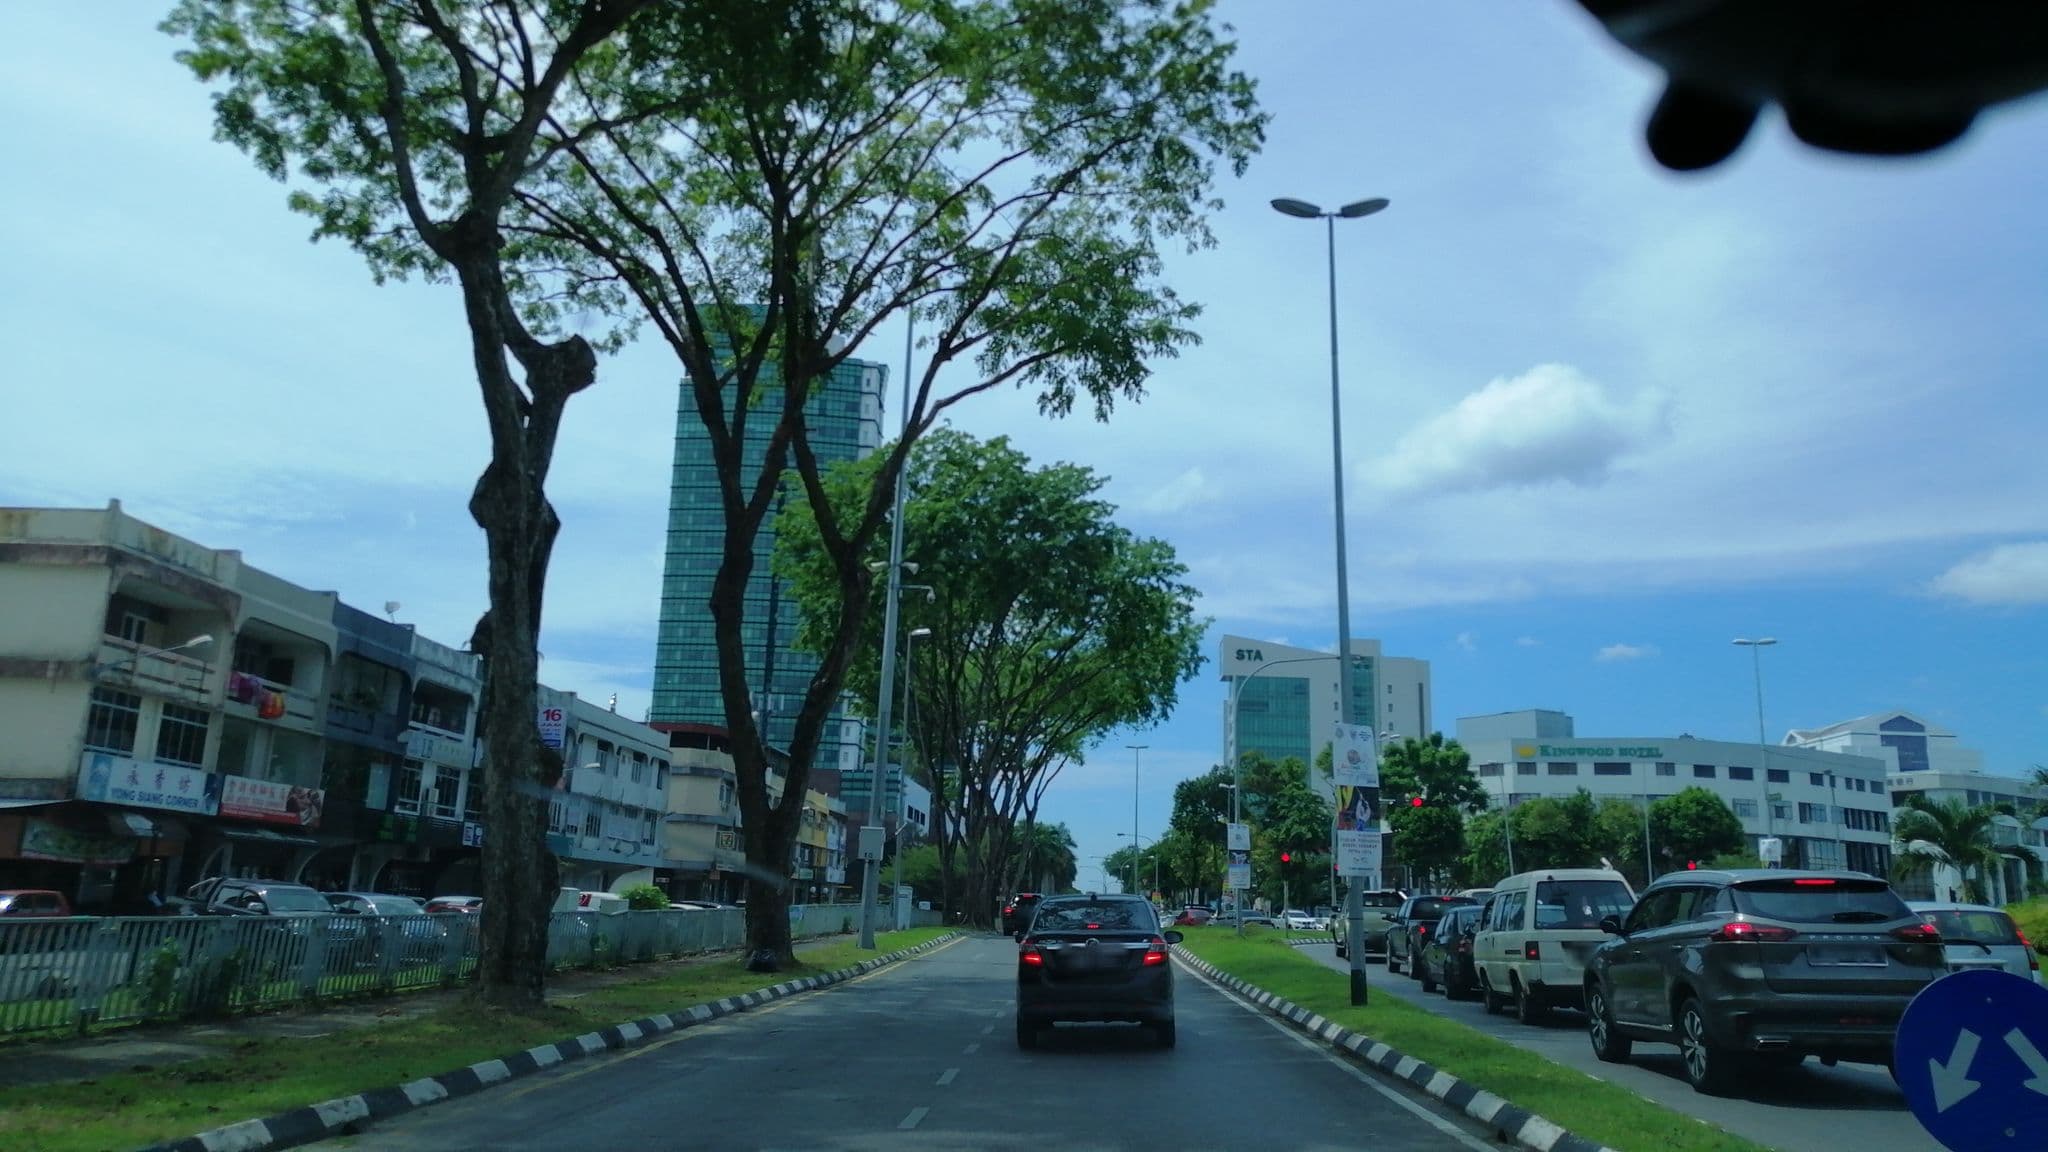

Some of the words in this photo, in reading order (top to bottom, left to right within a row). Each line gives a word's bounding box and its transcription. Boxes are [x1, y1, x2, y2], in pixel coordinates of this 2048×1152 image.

[1235, 649, 1263, 661] STA
[543, 709, 562, 721] 16
[1539, 745, 1615, 758] KINGWOOD
[1618, 746, 1663, 759] HOTEL
[165, 795, 199, 809] CORNER
